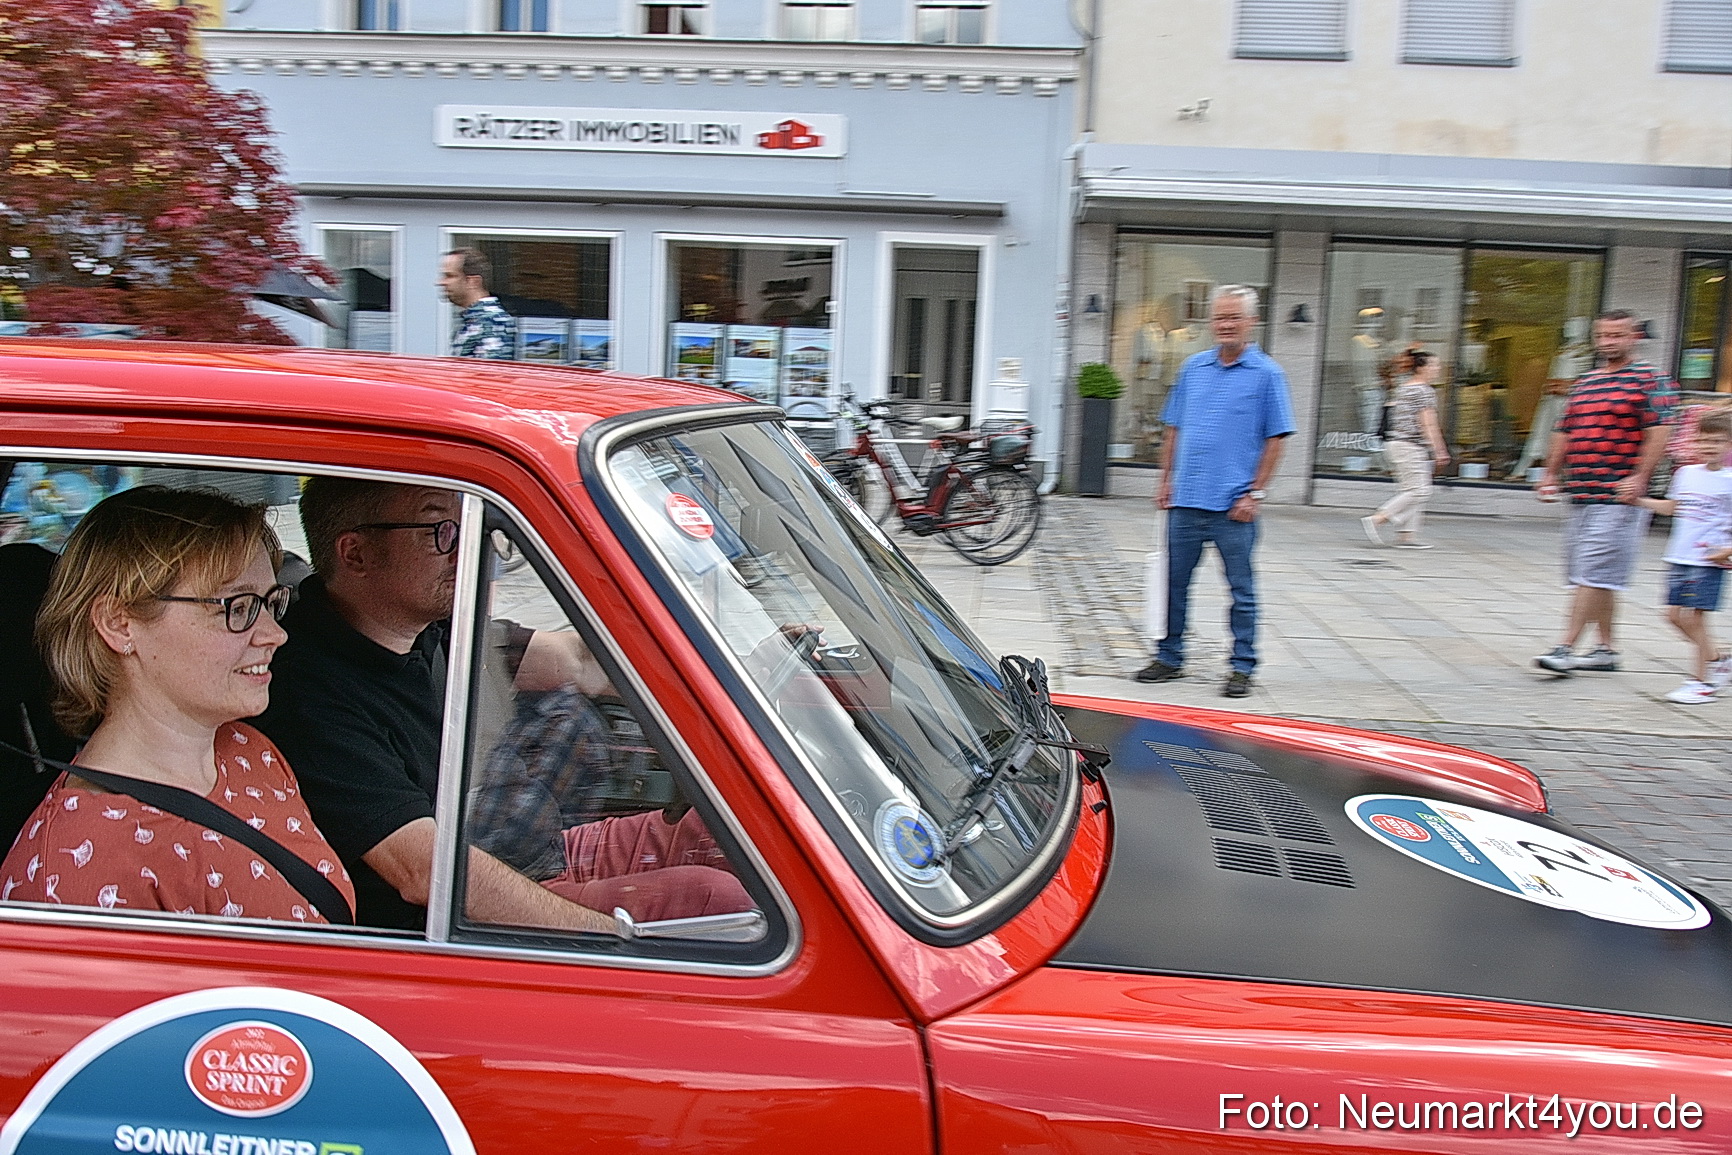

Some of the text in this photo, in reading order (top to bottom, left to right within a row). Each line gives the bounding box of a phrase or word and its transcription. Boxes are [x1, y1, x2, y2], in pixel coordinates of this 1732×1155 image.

[453, 113, 742, 146] RÄTZER IMMOBILIEN
[202, 1049, 298, 1077] CLASSIC
[205, 1070, 288, 1097] SPRINT
[114, 1124, 317, 1155] SONNLEITNER
